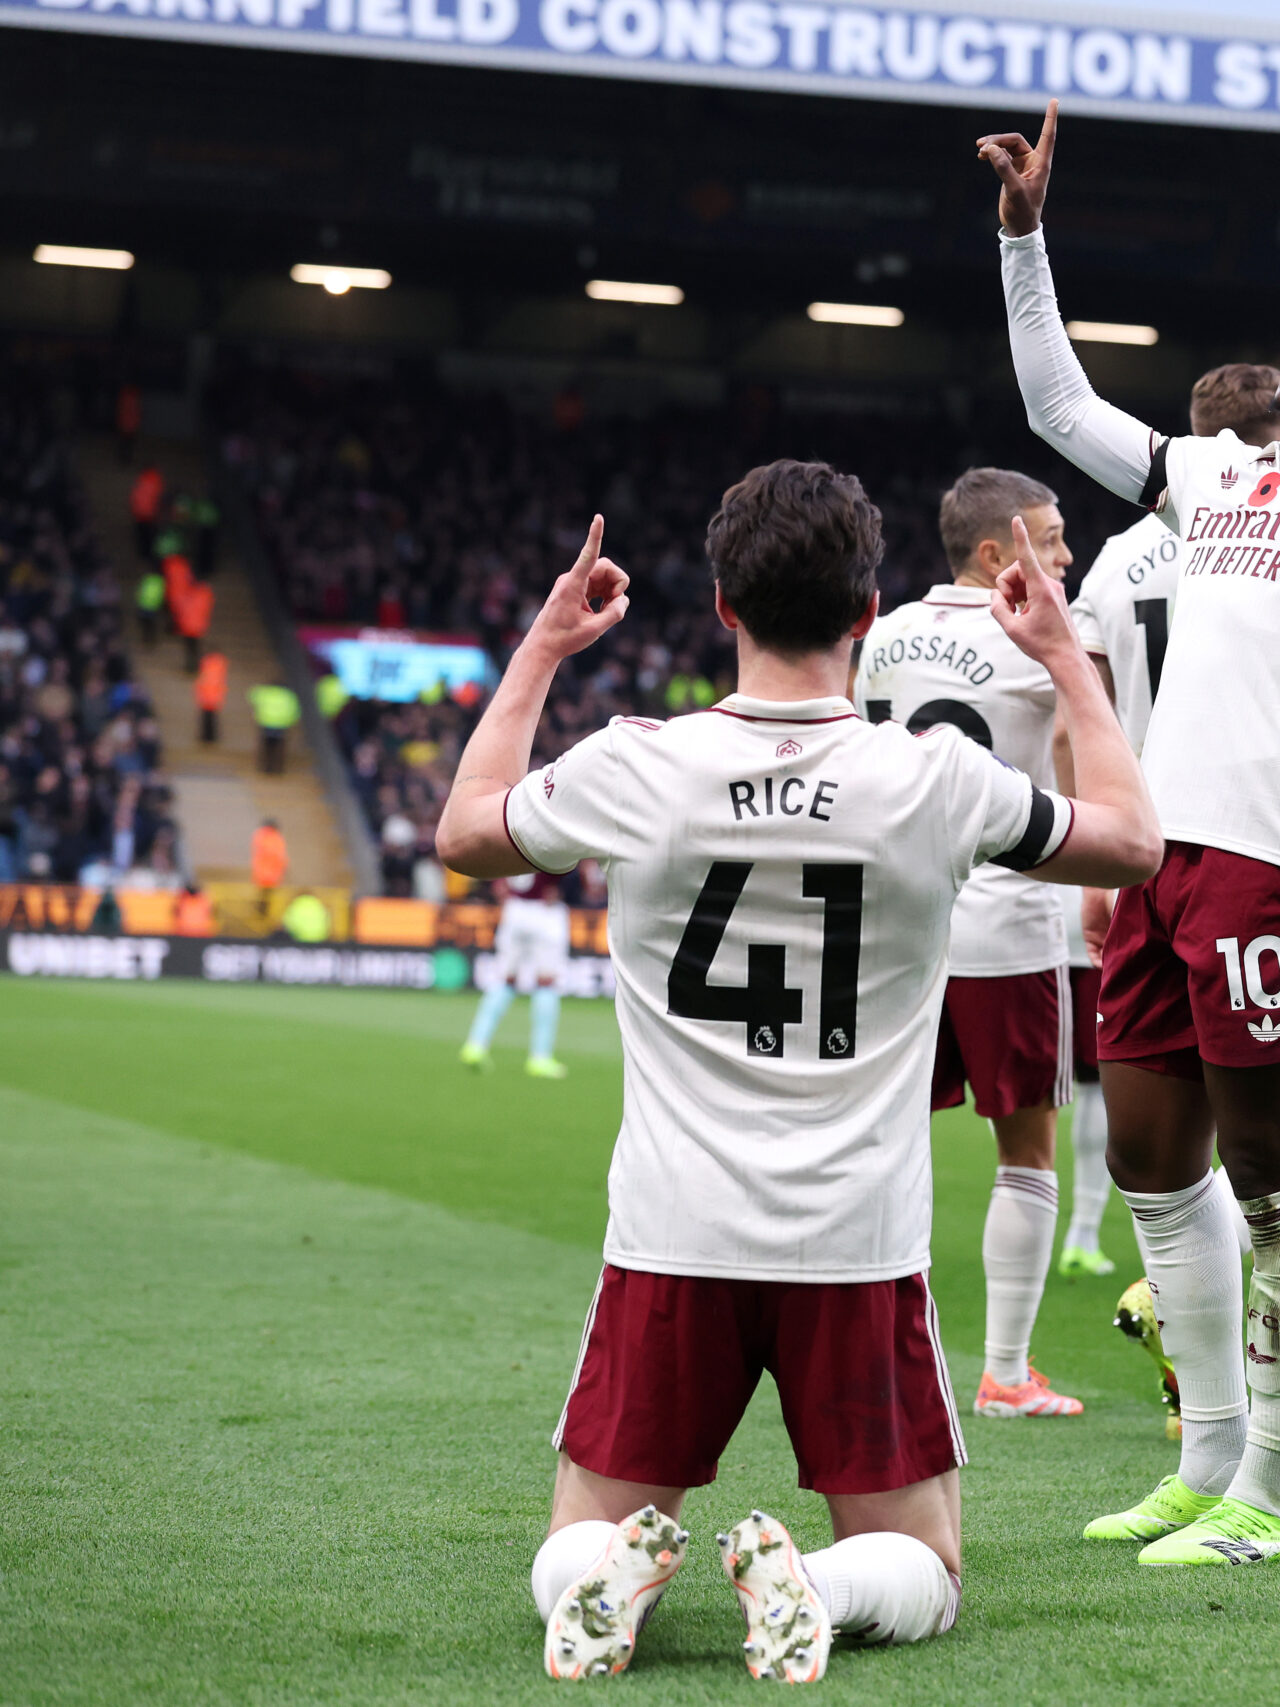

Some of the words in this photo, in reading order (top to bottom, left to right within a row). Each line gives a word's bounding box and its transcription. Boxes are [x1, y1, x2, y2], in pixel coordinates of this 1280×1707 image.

[539, 0, 1192, 102] CONSTRUCTION
[1185, 546, 1216, 576] FLY
[728, 777, 839, 822] RICE
[7, 932, 169, 979] UNIBET
[667, 861, 864, 1060] 41
